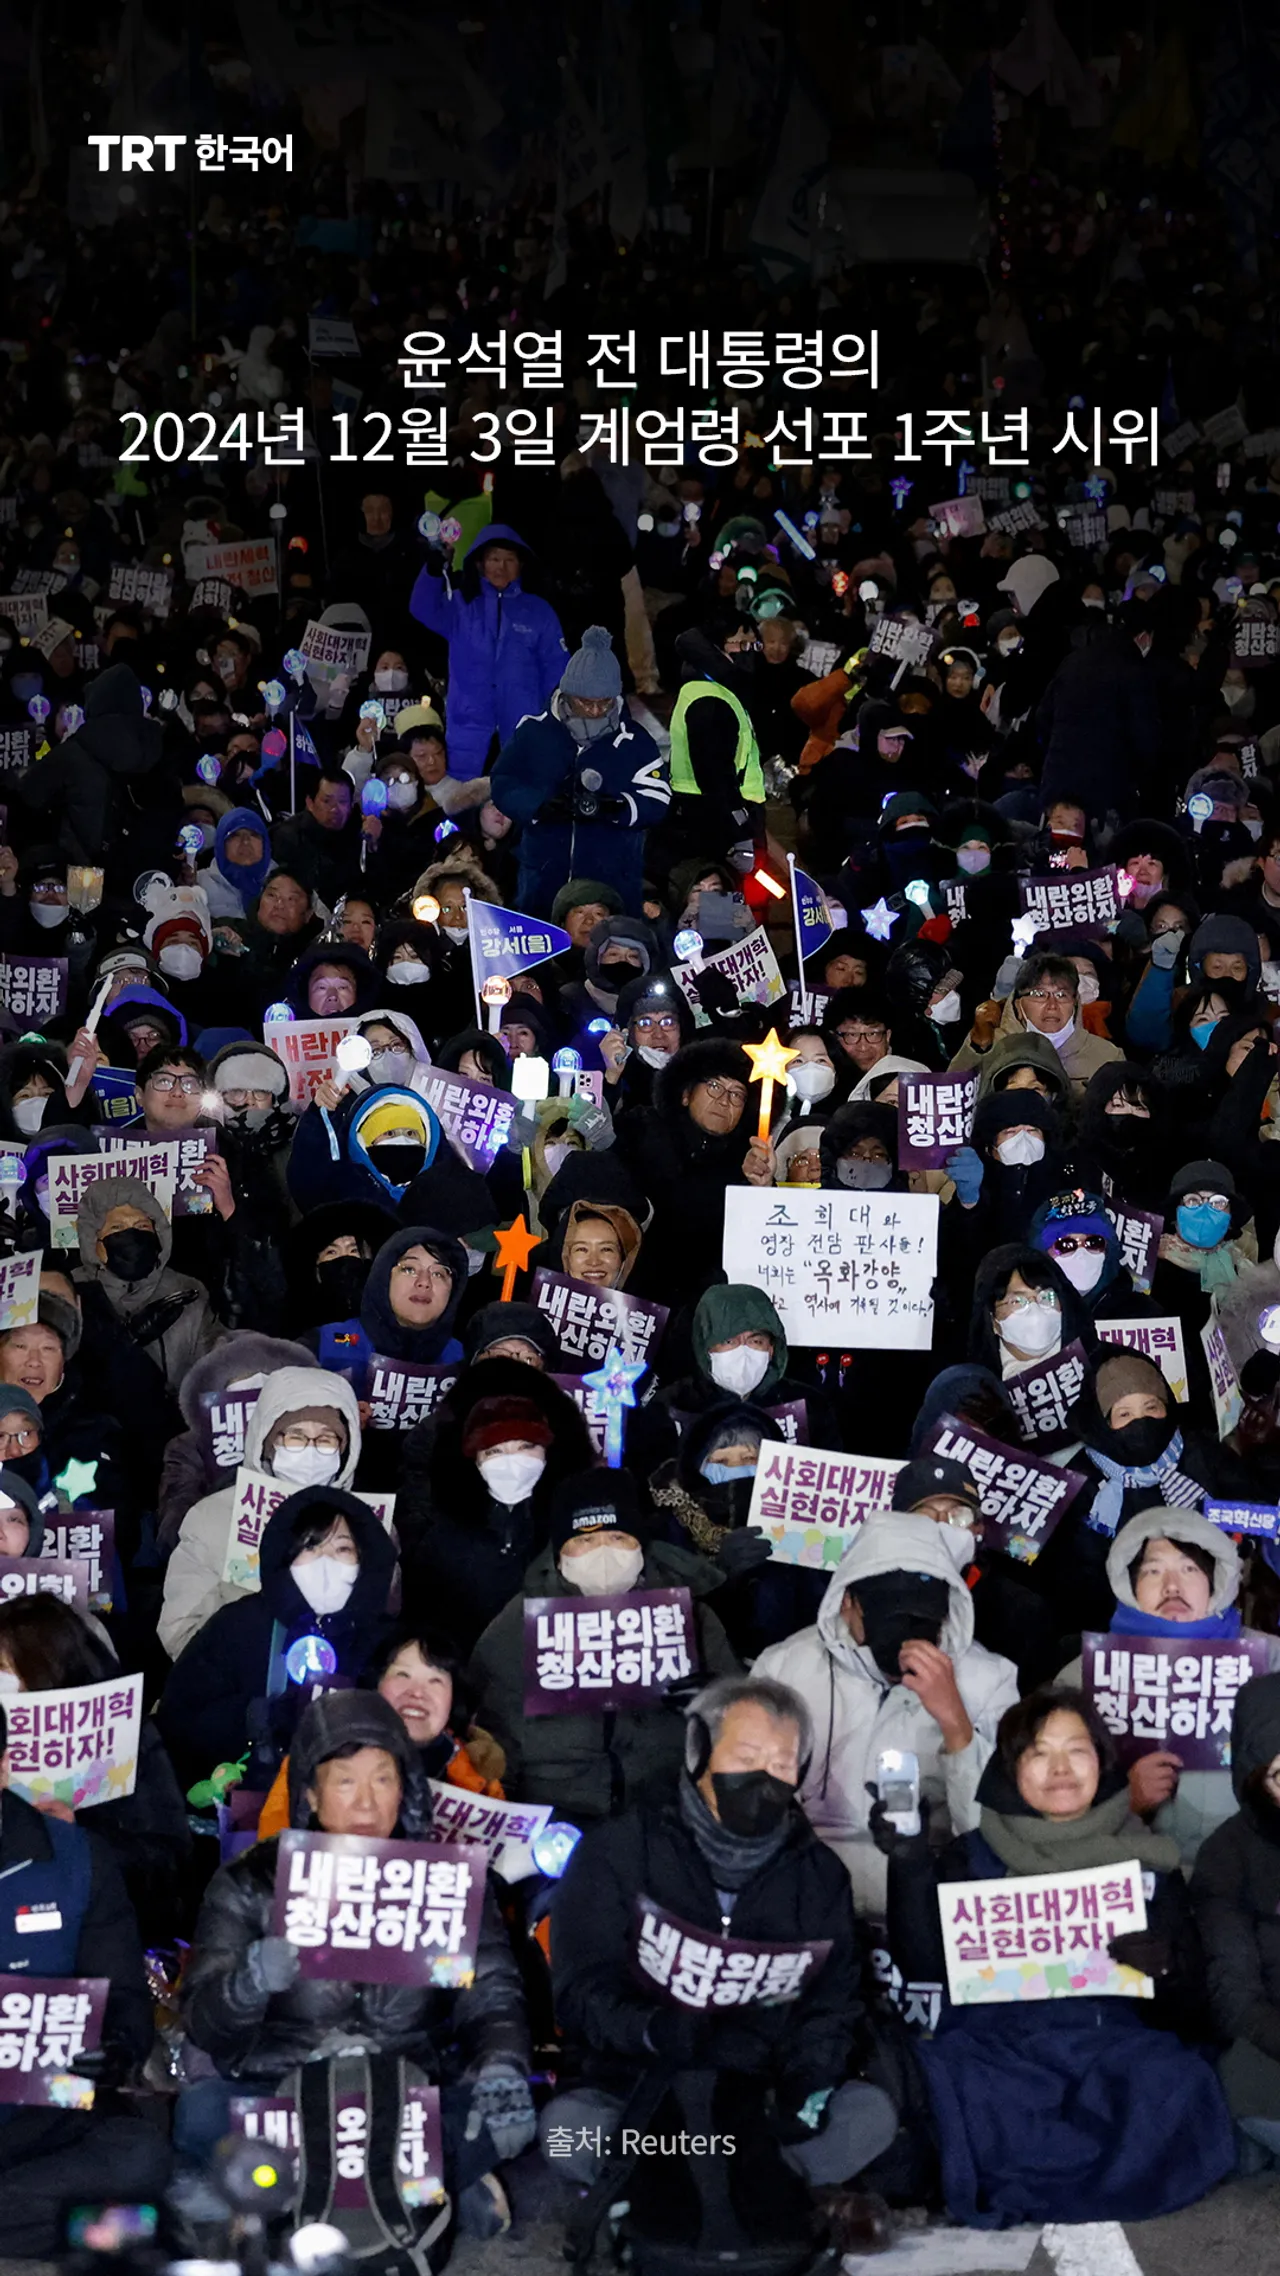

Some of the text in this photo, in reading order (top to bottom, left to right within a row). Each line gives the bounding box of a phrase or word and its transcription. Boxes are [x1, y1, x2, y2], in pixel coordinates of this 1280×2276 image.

[305, 627, 367, 651] 사회대개혁
[1026, 874, 1114, 909] 내란외환
[1029, 898, 1117, 932] 청산하자
[481, 933, 553, 958] 강서(을)
[681, 934, 769, 986] 사대개혁
[54, 1151, 169, 1189] 사회대개혁
[761, 1232, 925, 1257] 영장 전담 판사들!
[1118, 1244, 1148, 1275] 자
[537, 1282, 657, 1347] 내란외환
[804, 1293, 841, 1318] 역사에
[933, 1429, 1068, 1510] 내란외환
[572, 1513, 617, 1530] amazon
[1207, 1507, 1276, 1530] 조국혁신당
[536, 1602, 688, 1652] 내란외환
[535, 1641, 692, 1690] 청산하자
[1093, 1650, 1253, 1699] 내란외환
[8, 1687, 135, 1738] 회대개혁
[8, 1726, 115, 1773] 현하자!
[288, 1850, 473, 1910] 내란외환
[952, 1877, 1136, 1927] 사회대개혁
[284, 1896, 468, 1954] 청산하자
[640, 1911, 814, 1982] 내란외환
[954, 1922, 1116, 1962] 실현하자!
[0, 1992, 93, 2034] 외환
